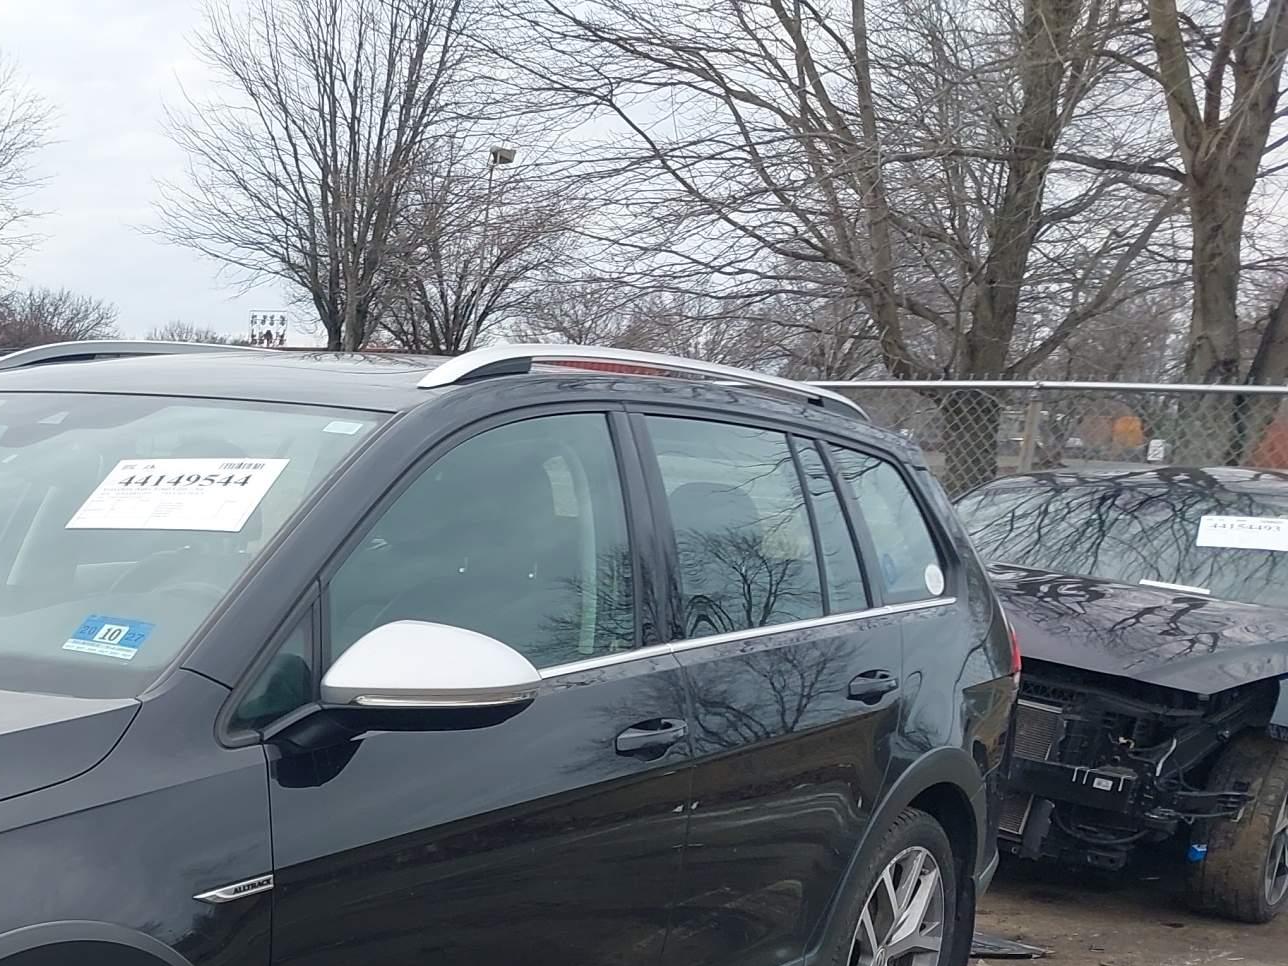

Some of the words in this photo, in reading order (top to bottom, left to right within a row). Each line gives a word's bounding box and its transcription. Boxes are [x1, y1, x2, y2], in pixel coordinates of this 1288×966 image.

[118, 474, 253, 487] 44149544
[98, 628, 123, 642] 10
[124, 632, 145, 642] 27
[232, 879, 272, 895] ALLTRACK
